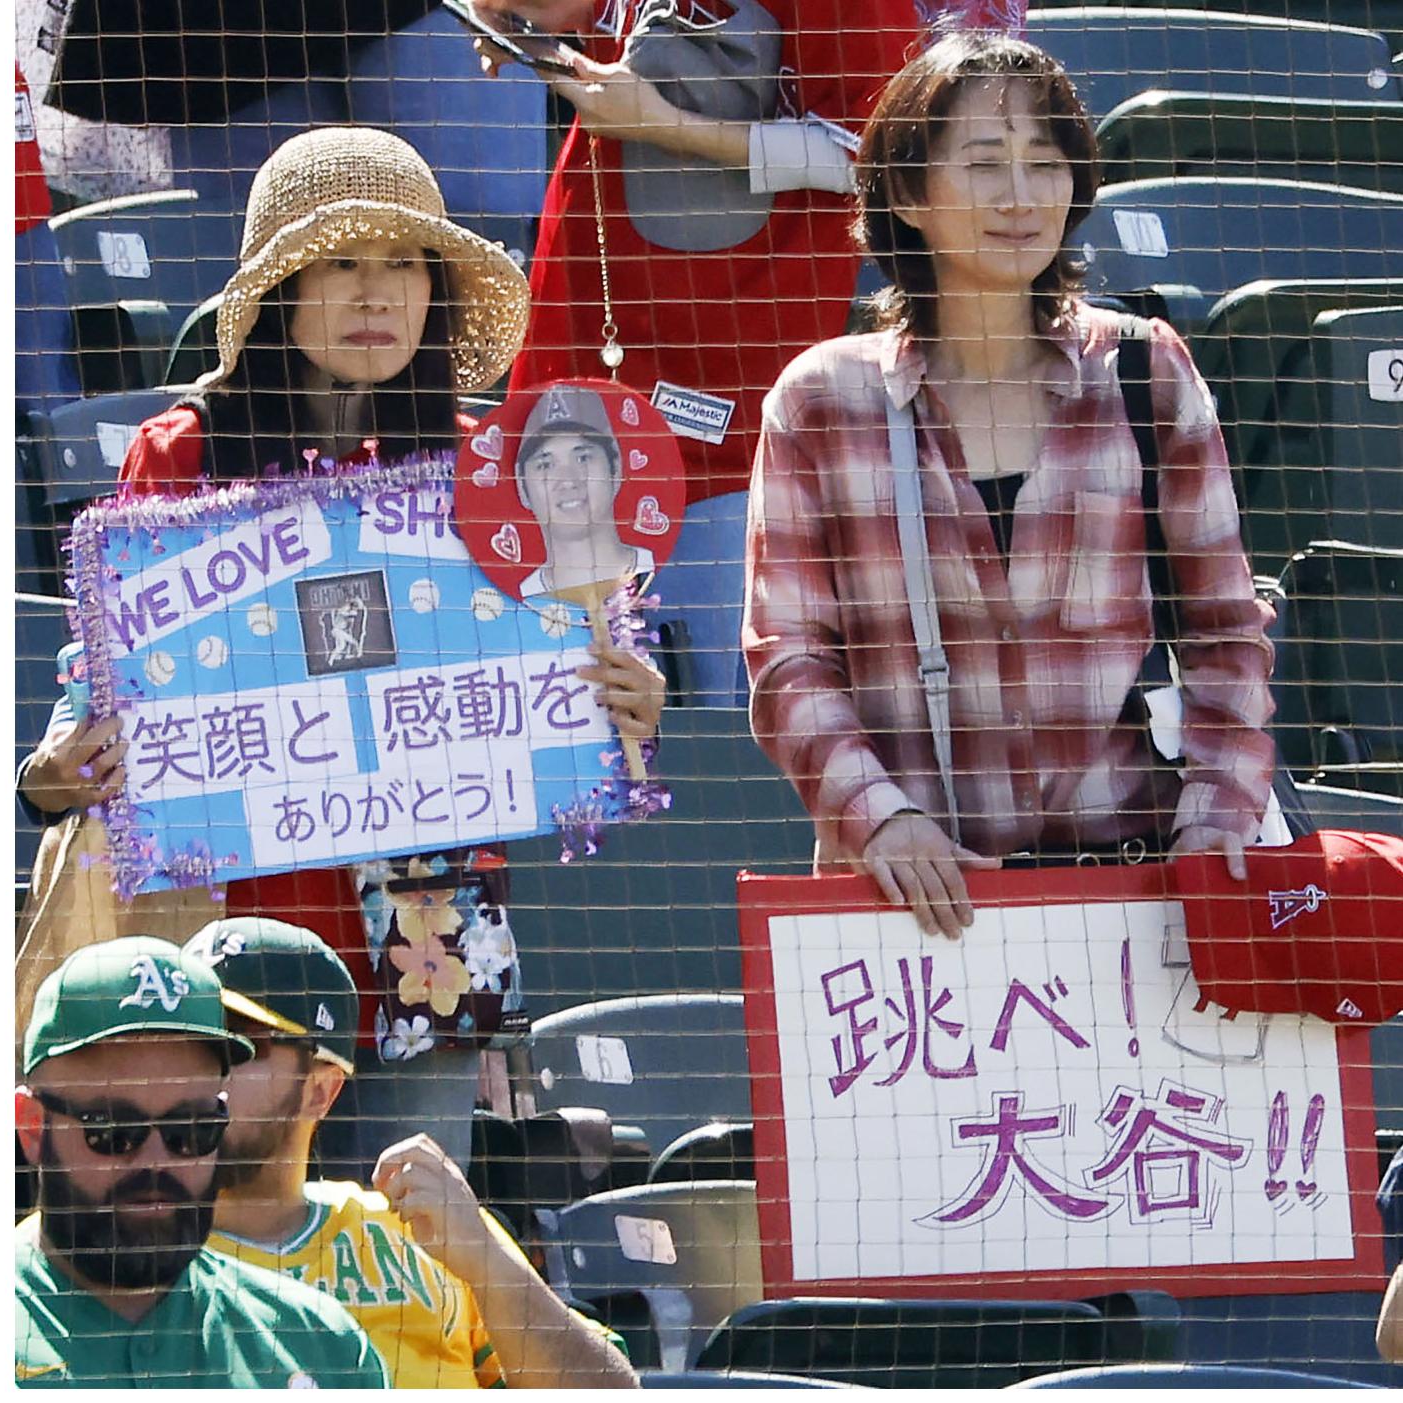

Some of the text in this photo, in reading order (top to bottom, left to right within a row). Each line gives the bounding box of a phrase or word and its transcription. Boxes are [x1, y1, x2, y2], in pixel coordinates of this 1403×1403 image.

[680, 400, 723, 421] Majestic
[108, 492, 465, 652] WE LOVE SH
[132, 661, 591, 790] 笑顔と 感動を
[119, 954, 190, 1013] A's
